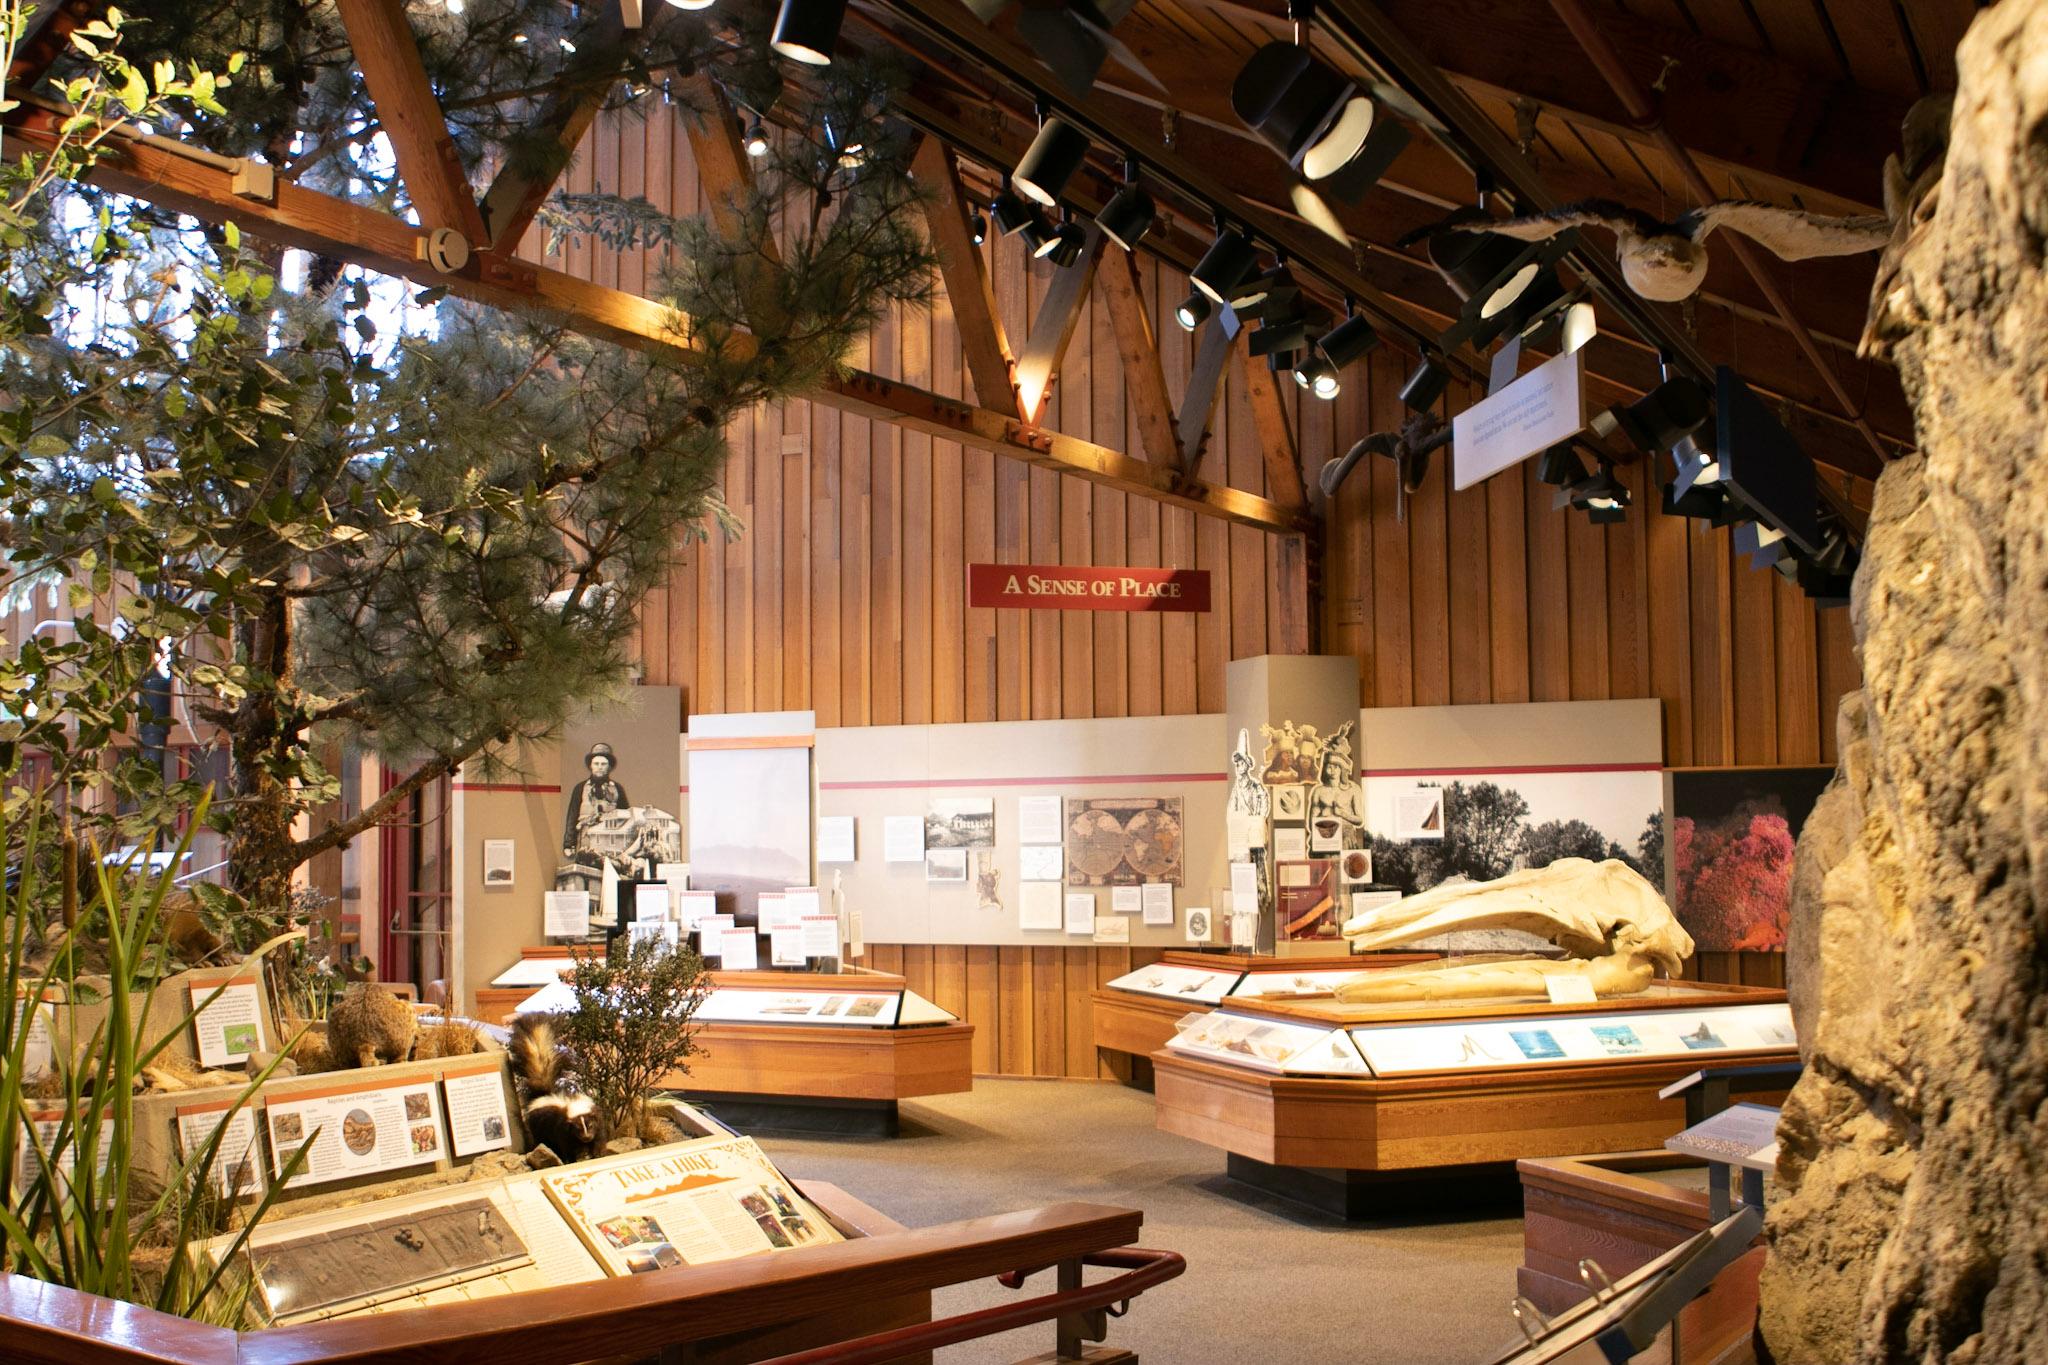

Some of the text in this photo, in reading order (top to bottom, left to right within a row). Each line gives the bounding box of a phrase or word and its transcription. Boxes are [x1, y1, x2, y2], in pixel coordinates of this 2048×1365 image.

[1003, 574, 1023, 594] A
[609, 1152, 720, 1188] TAKE A HIKE
